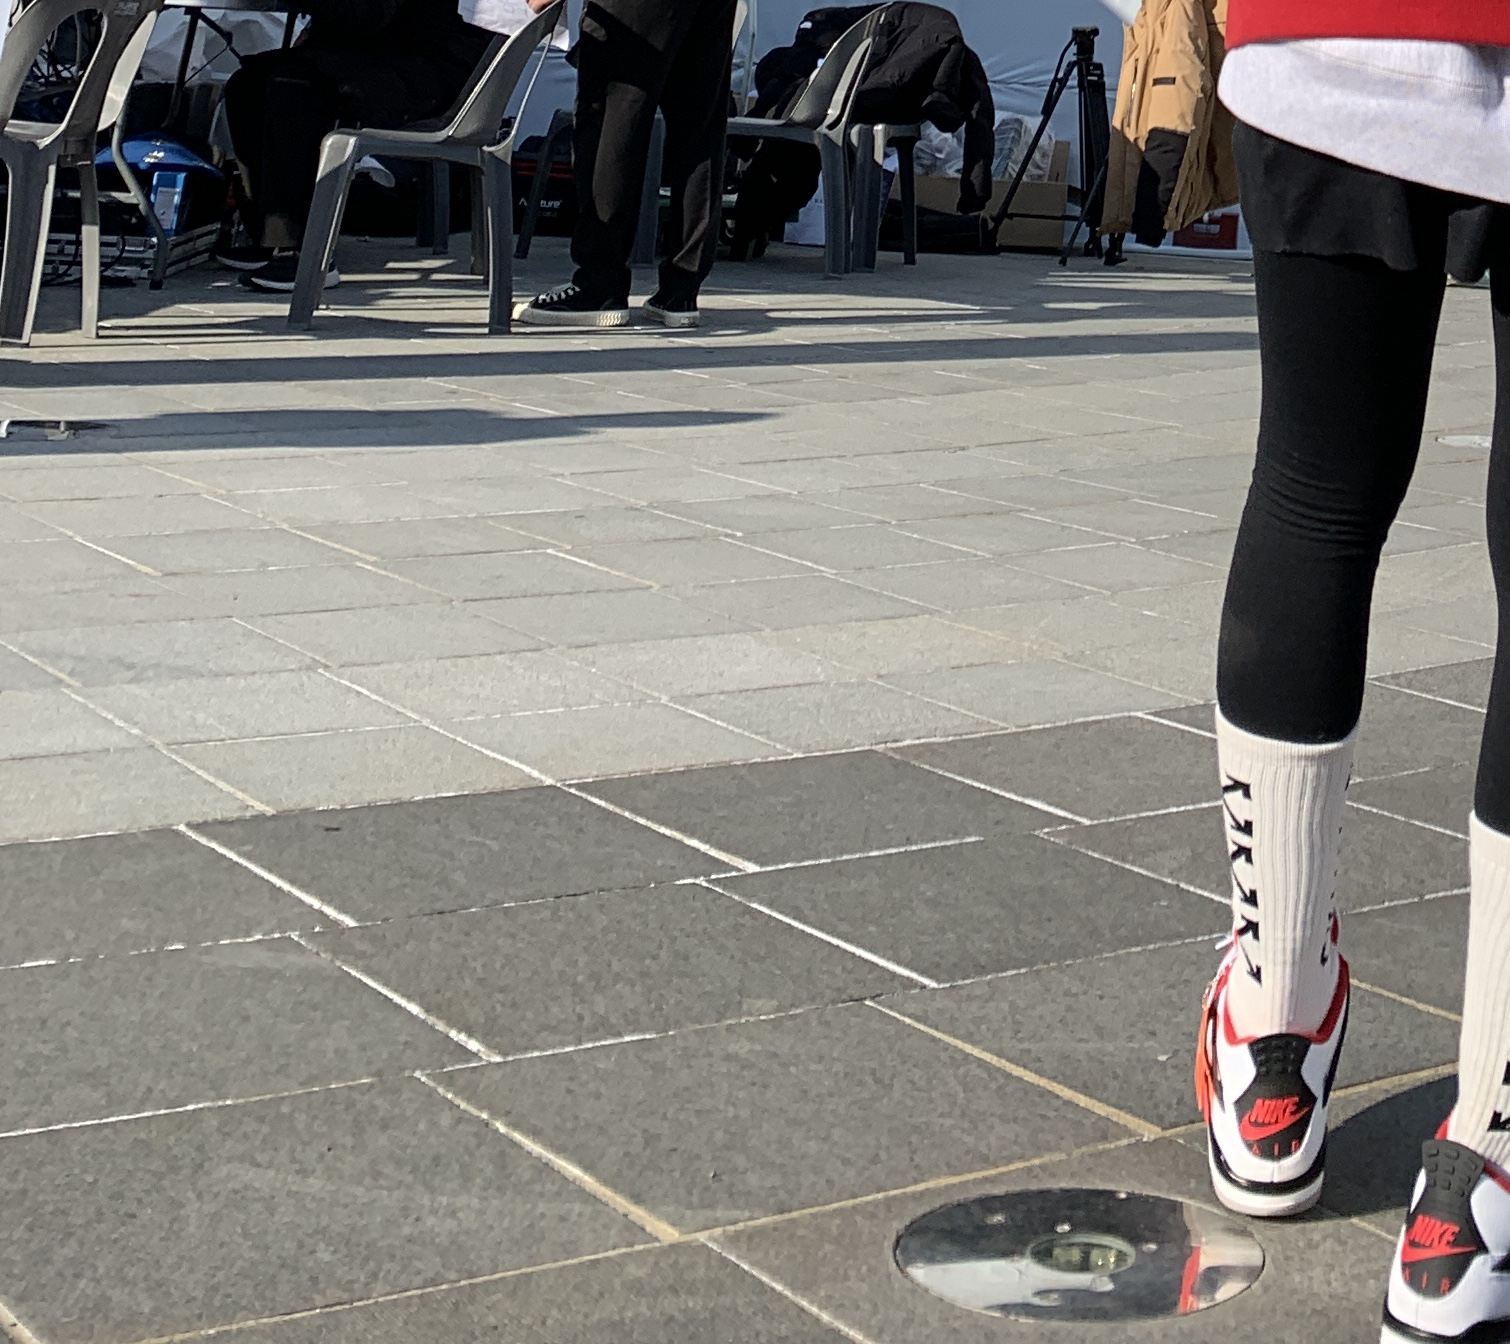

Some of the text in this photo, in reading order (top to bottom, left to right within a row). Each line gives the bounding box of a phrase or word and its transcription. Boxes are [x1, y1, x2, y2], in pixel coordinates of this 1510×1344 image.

[1249, 1096, 1300, 1124] NIKE
[1252, 1139, 1300, 1157] AIR
[1409, 1214, 1461, 1249] NIKE
